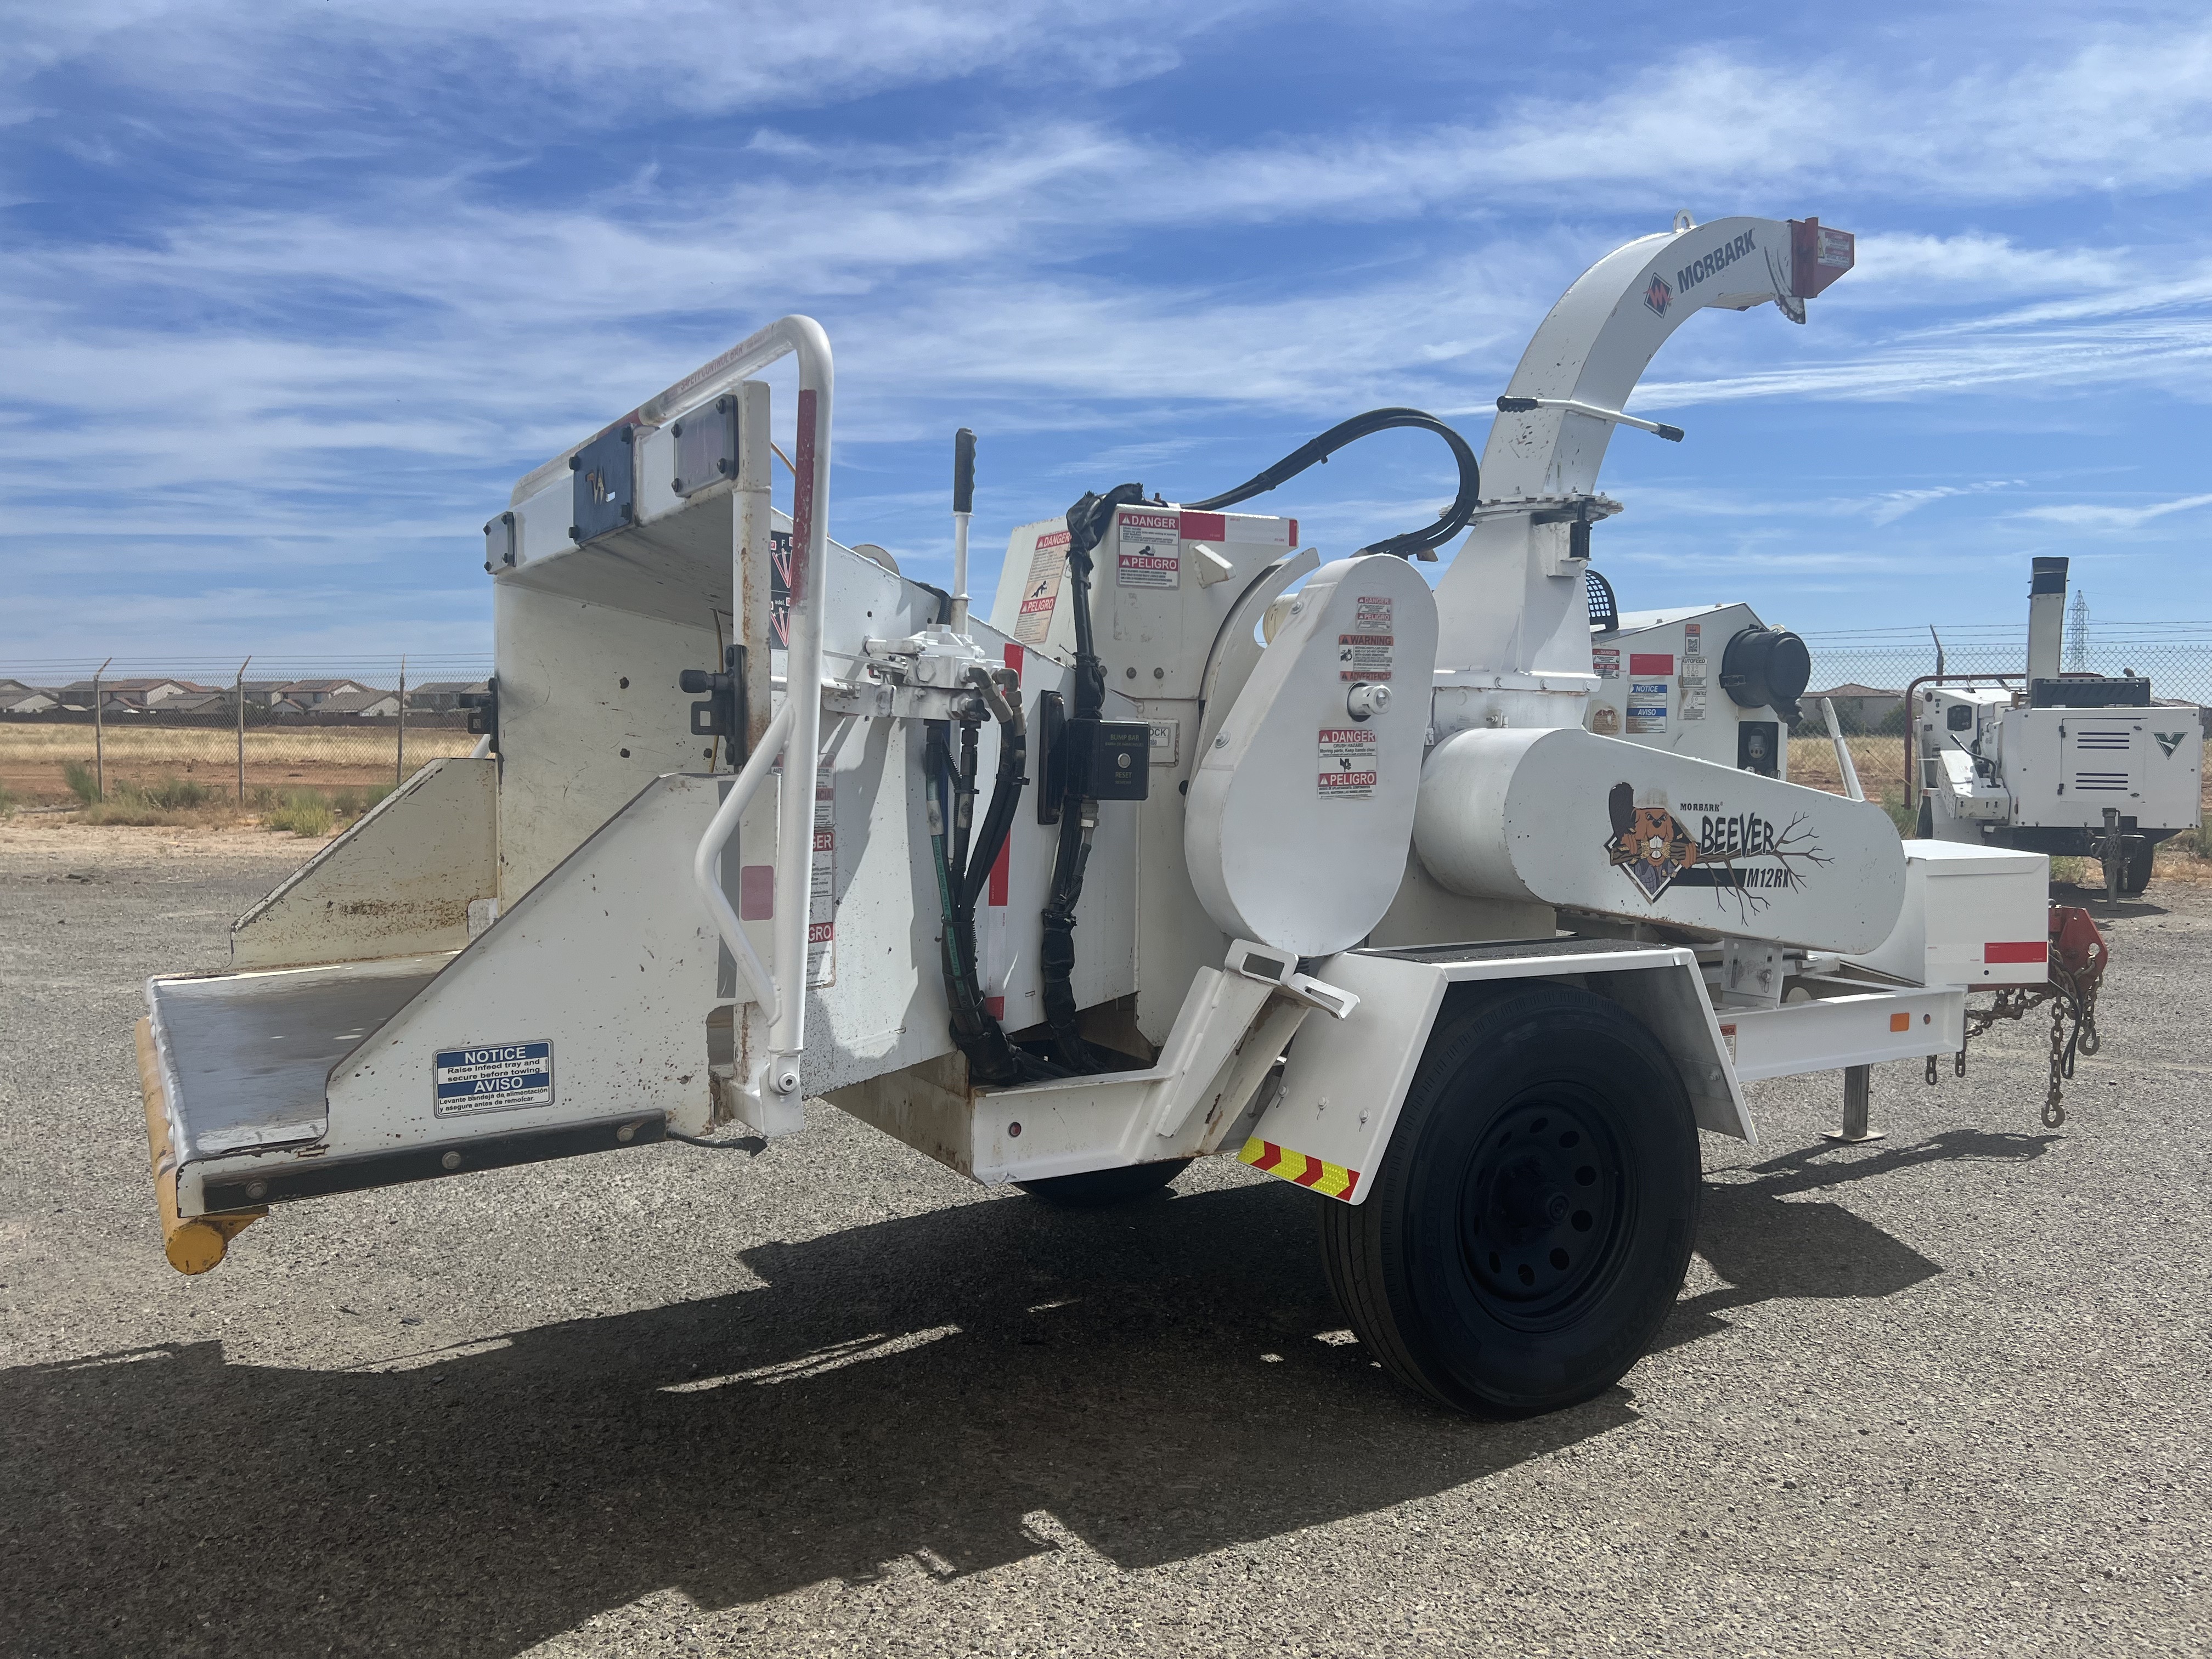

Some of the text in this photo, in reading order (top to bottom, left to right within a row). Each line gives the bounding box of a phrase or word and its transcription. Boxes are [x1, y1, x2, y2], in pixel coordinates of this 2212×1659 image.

[1677, 229, 1756, 294] MORBARK
[1132, 516, 1175, 528] DANGER
[1043, 532, 1070, 548] DANGER
[1132, 557, 1177, 569] PELIGRO
[1026, 599, 1054, 612] PELIGRO
[1352, 636, 1391, 645] WARNING
[1332, 731, 1374, 742] DANGER
[1330, 773, 1374, 785] PELIGRO
[1680, 803, 1720, 812] MORBARK
[1701, 812, 1775, 857] BEEVER
[1746, 868, 1788, 888] M12RX
[465, 1047, 526, 1064] NOTICE
[474, 1077, 523, 1093] AVISO
[506, 1087, 548, 1097] alimentación
